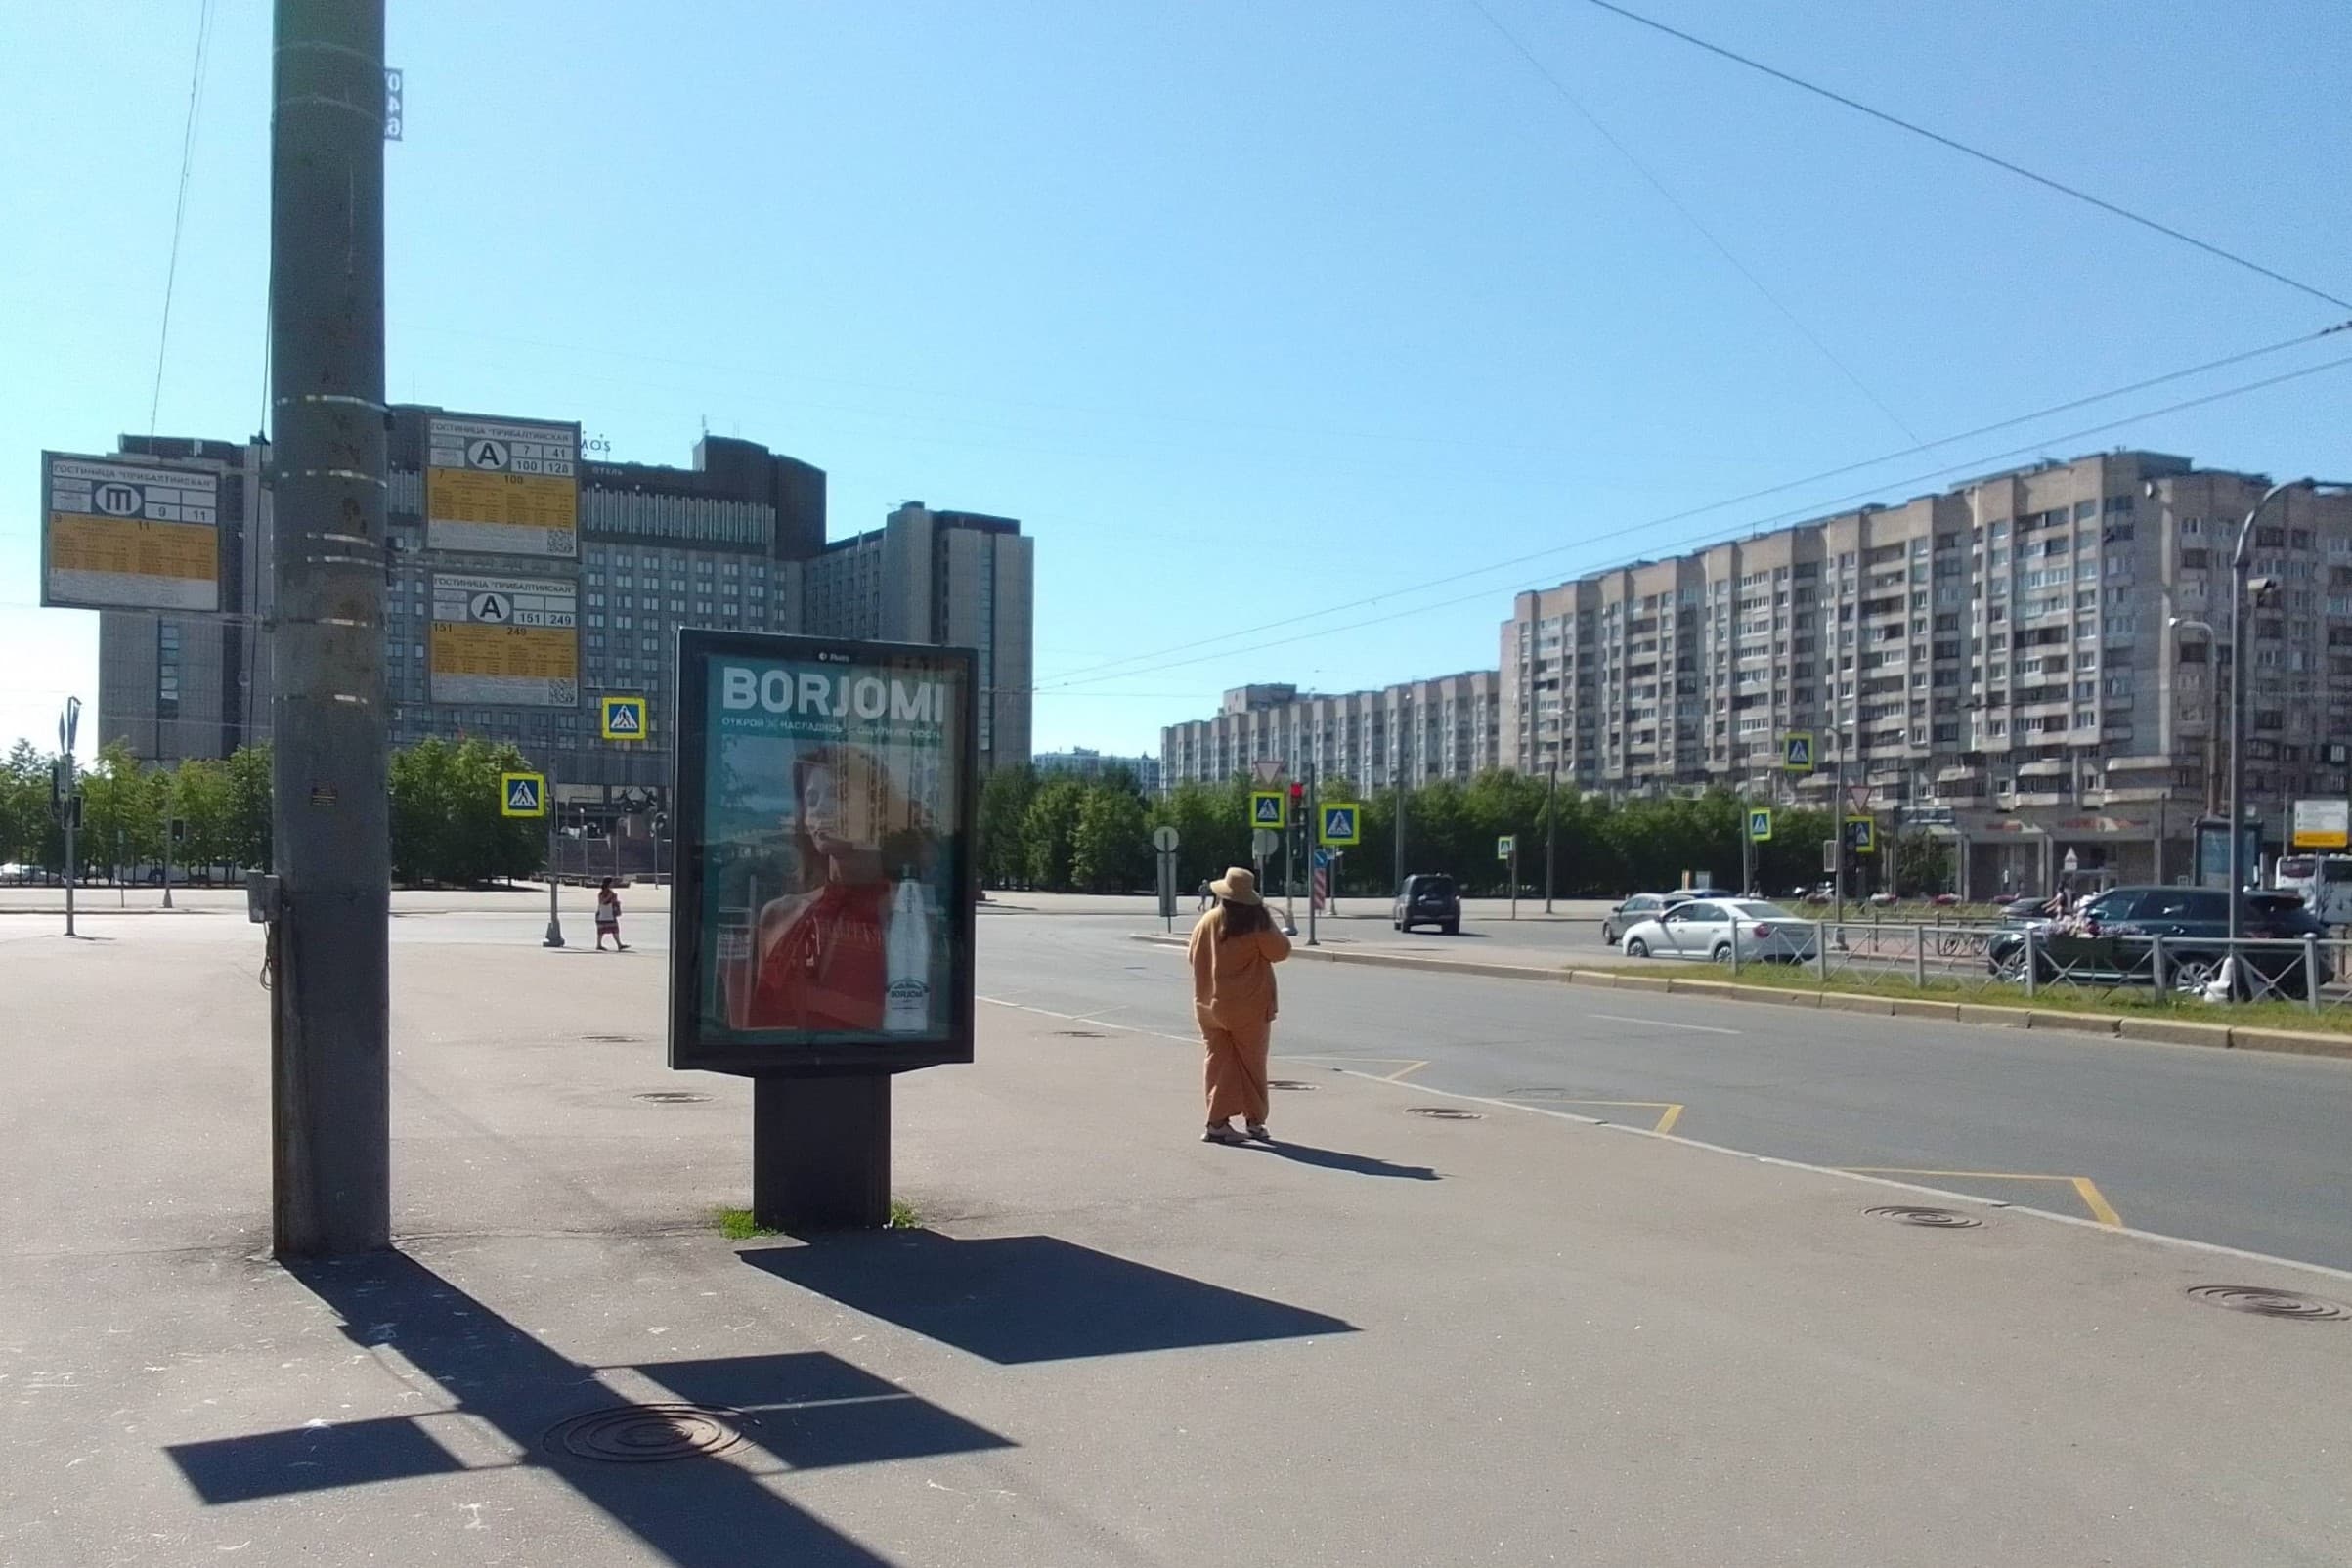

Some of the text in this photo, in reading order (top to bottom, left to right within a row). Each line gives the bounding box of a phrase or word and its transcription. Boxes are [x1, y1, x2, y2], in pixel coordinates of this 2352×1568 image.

[431, 422, 486, 436] ГОСТИНИЦА
[476, 442, 501, 466] А
[524, 445, 565, 458] 7 41
[54, 464, 115, 479] ГОСТИНИЦА
[516, 460, 569, 474] 100 128
[504, 474, 524, 485] 100
[54, 513, 63, 524] 9
[158, 506, 206, 521] 9 11
[434, 577, 489, 589] ГОСТИНИЦА
[479, 595, 502, 619] А
[520, 613, 572, 625] 151 249
[434, 622, 528, 636] 151 249
[722, 666, 945, 723] BORJOMI
[721, 716, 765, 728] ОТКРОЙ
